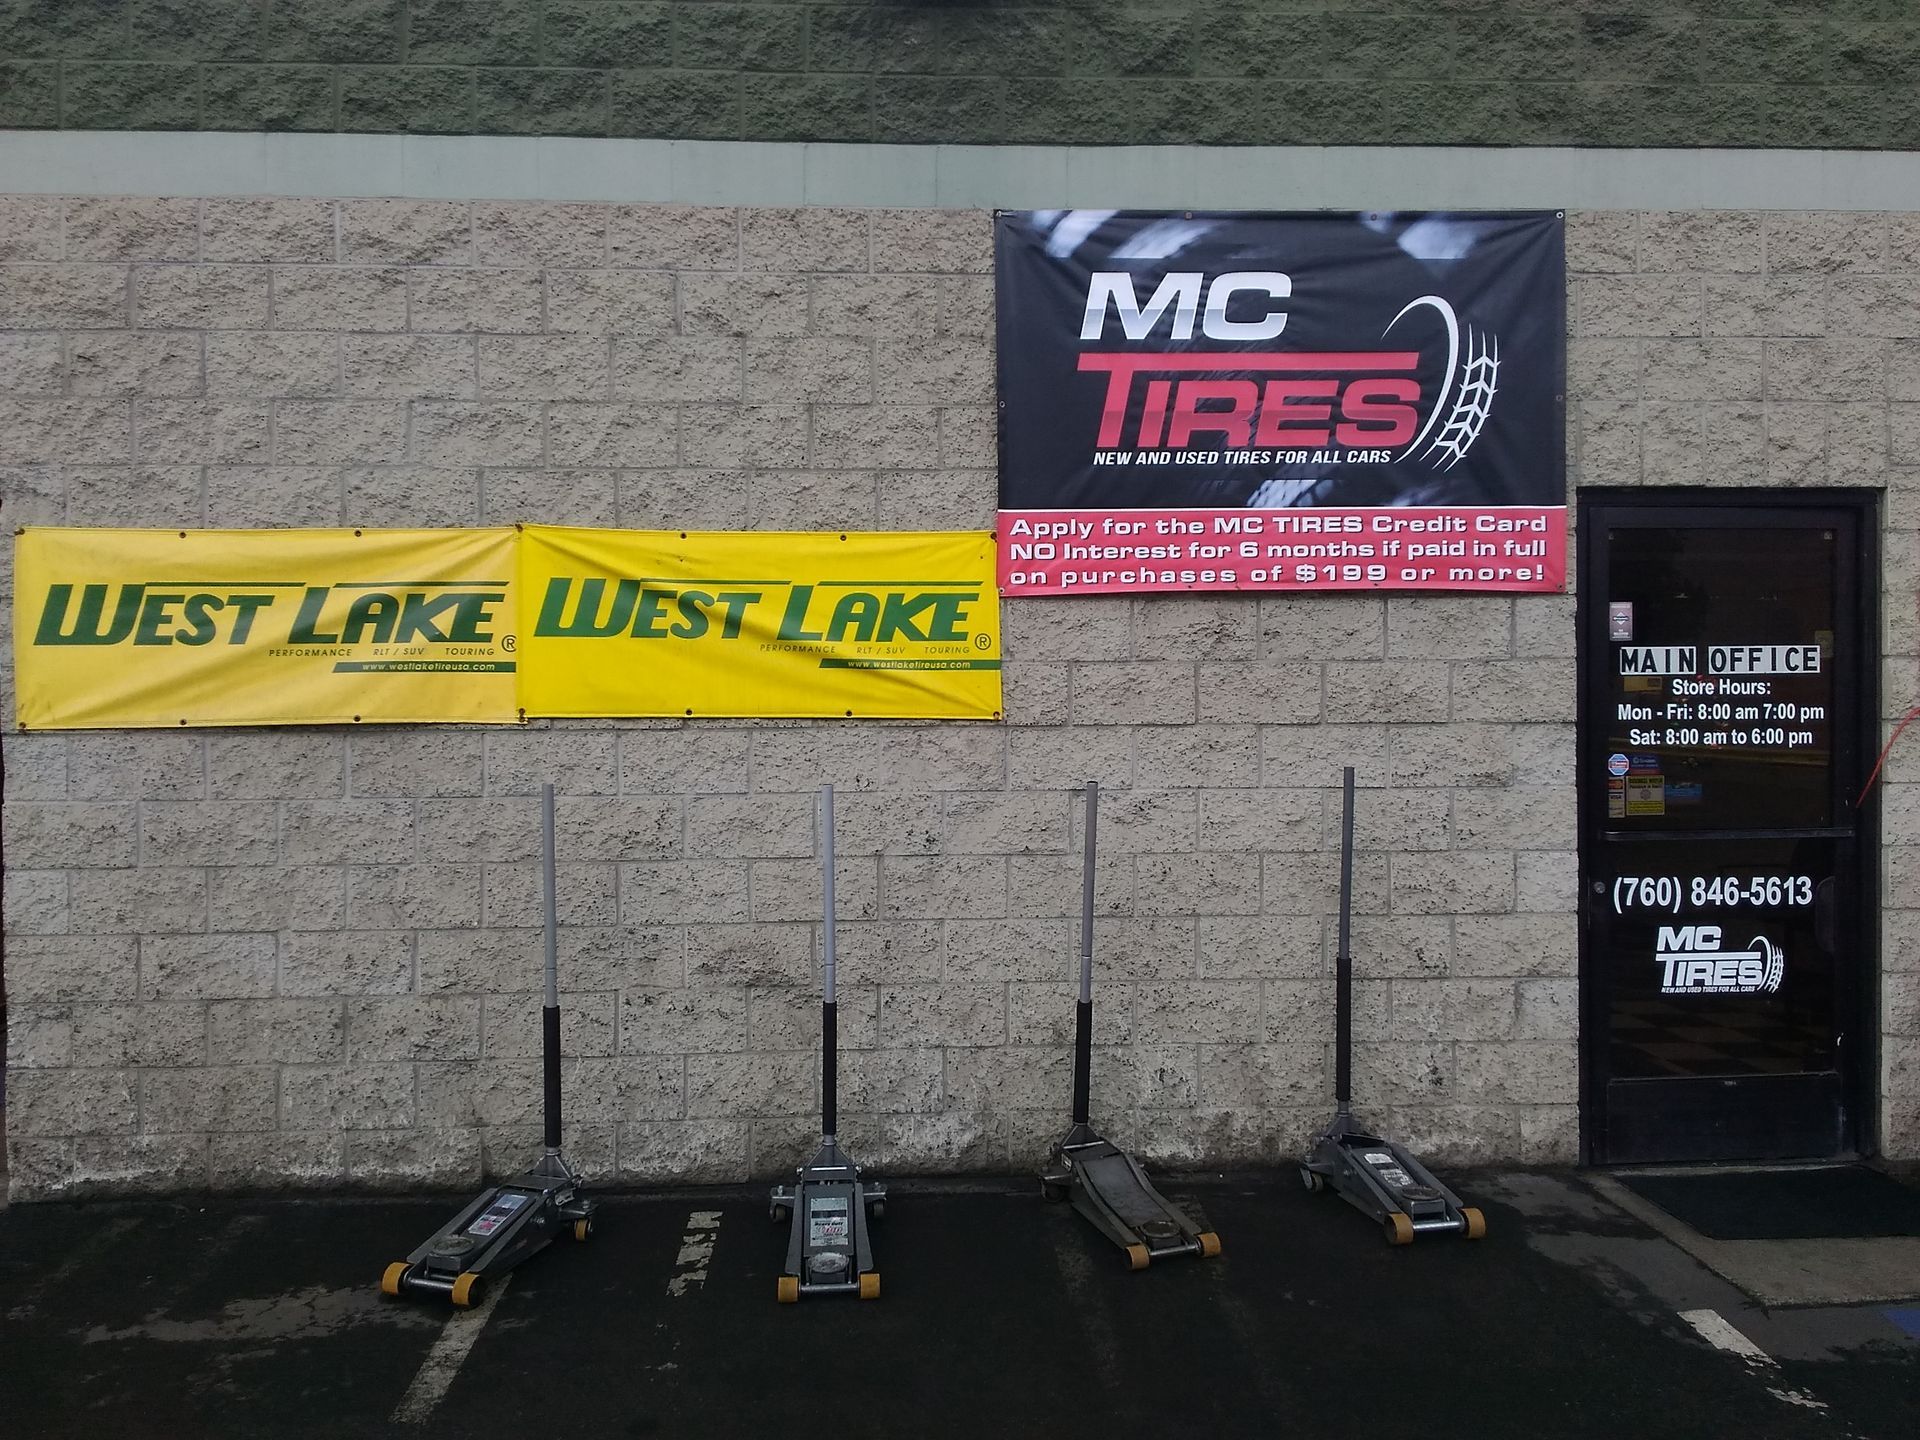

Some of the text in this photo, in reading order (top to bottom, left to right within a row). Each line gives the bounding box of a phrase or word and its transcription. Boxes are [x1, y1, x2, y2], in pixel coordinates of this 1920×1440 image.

[1079, 271, 1293, 341] MC
[1077, 352, 1422, 449] TIRES
[1093, 450, 1392, 466] NEW AND USED TIRES FOR ALL CARS
[1009, 515, 1547, 540] Apply for the MC TIRES Credit Card
[1010, 539, 1546, 561] NO Interest for 6 months if paid in full
[1010, 563, 1545, 588] on purchases of $199 or more!
[33, 583, 277, 646] WEST
[287, 584, 507, 646] LAKE
[533, 577, 762, 639] WEST
[776, 583, 981, 643] LAKE
[268, 648, 352, 658] PERFORMANCE
[373, 647, 390, 656] RLT
[403, 647, 425, 656] SUV
[445, 647, 495, 656] TOURING
[759, 643, 836, 654] PERFORMANCE
[856, 646, 875, 655] RLT
[886, 646, 906, 655] SUV
[924, 646, 970, 655] TOURING
[1621, 646, 1819, 674] MAIN OFFICE
[362, 663, 496, 672] www.westlaketireusa.com
[847, 660, 971, 670] www.westlaketireusa.com
[1672, 678, 1772, 695] Store Hours:
[1617, 704, 1652, 721] Mon
[1667, 703, 1693, 720] Fri:
[1698, 703, 1731, 720] 8:00
[1735, 706, 1759, 720] am
[1763, 703, 1796, 719] 7:00
[1800, 706, 1825, 723] pm
[1629, 728, 1813, 748] Sat: 8:00 am to 6:00 pm
[1613, 875, 1813, 914] (760) 846-5613
[1656, 926, 1722, 951] MC
[1656, 951, 1763, 987] TIRES
[1661, 986, 1675, 994] NEW
[1718, 985, 1730, 993] FOR
[1729, 985, 1740, 993] ALL
